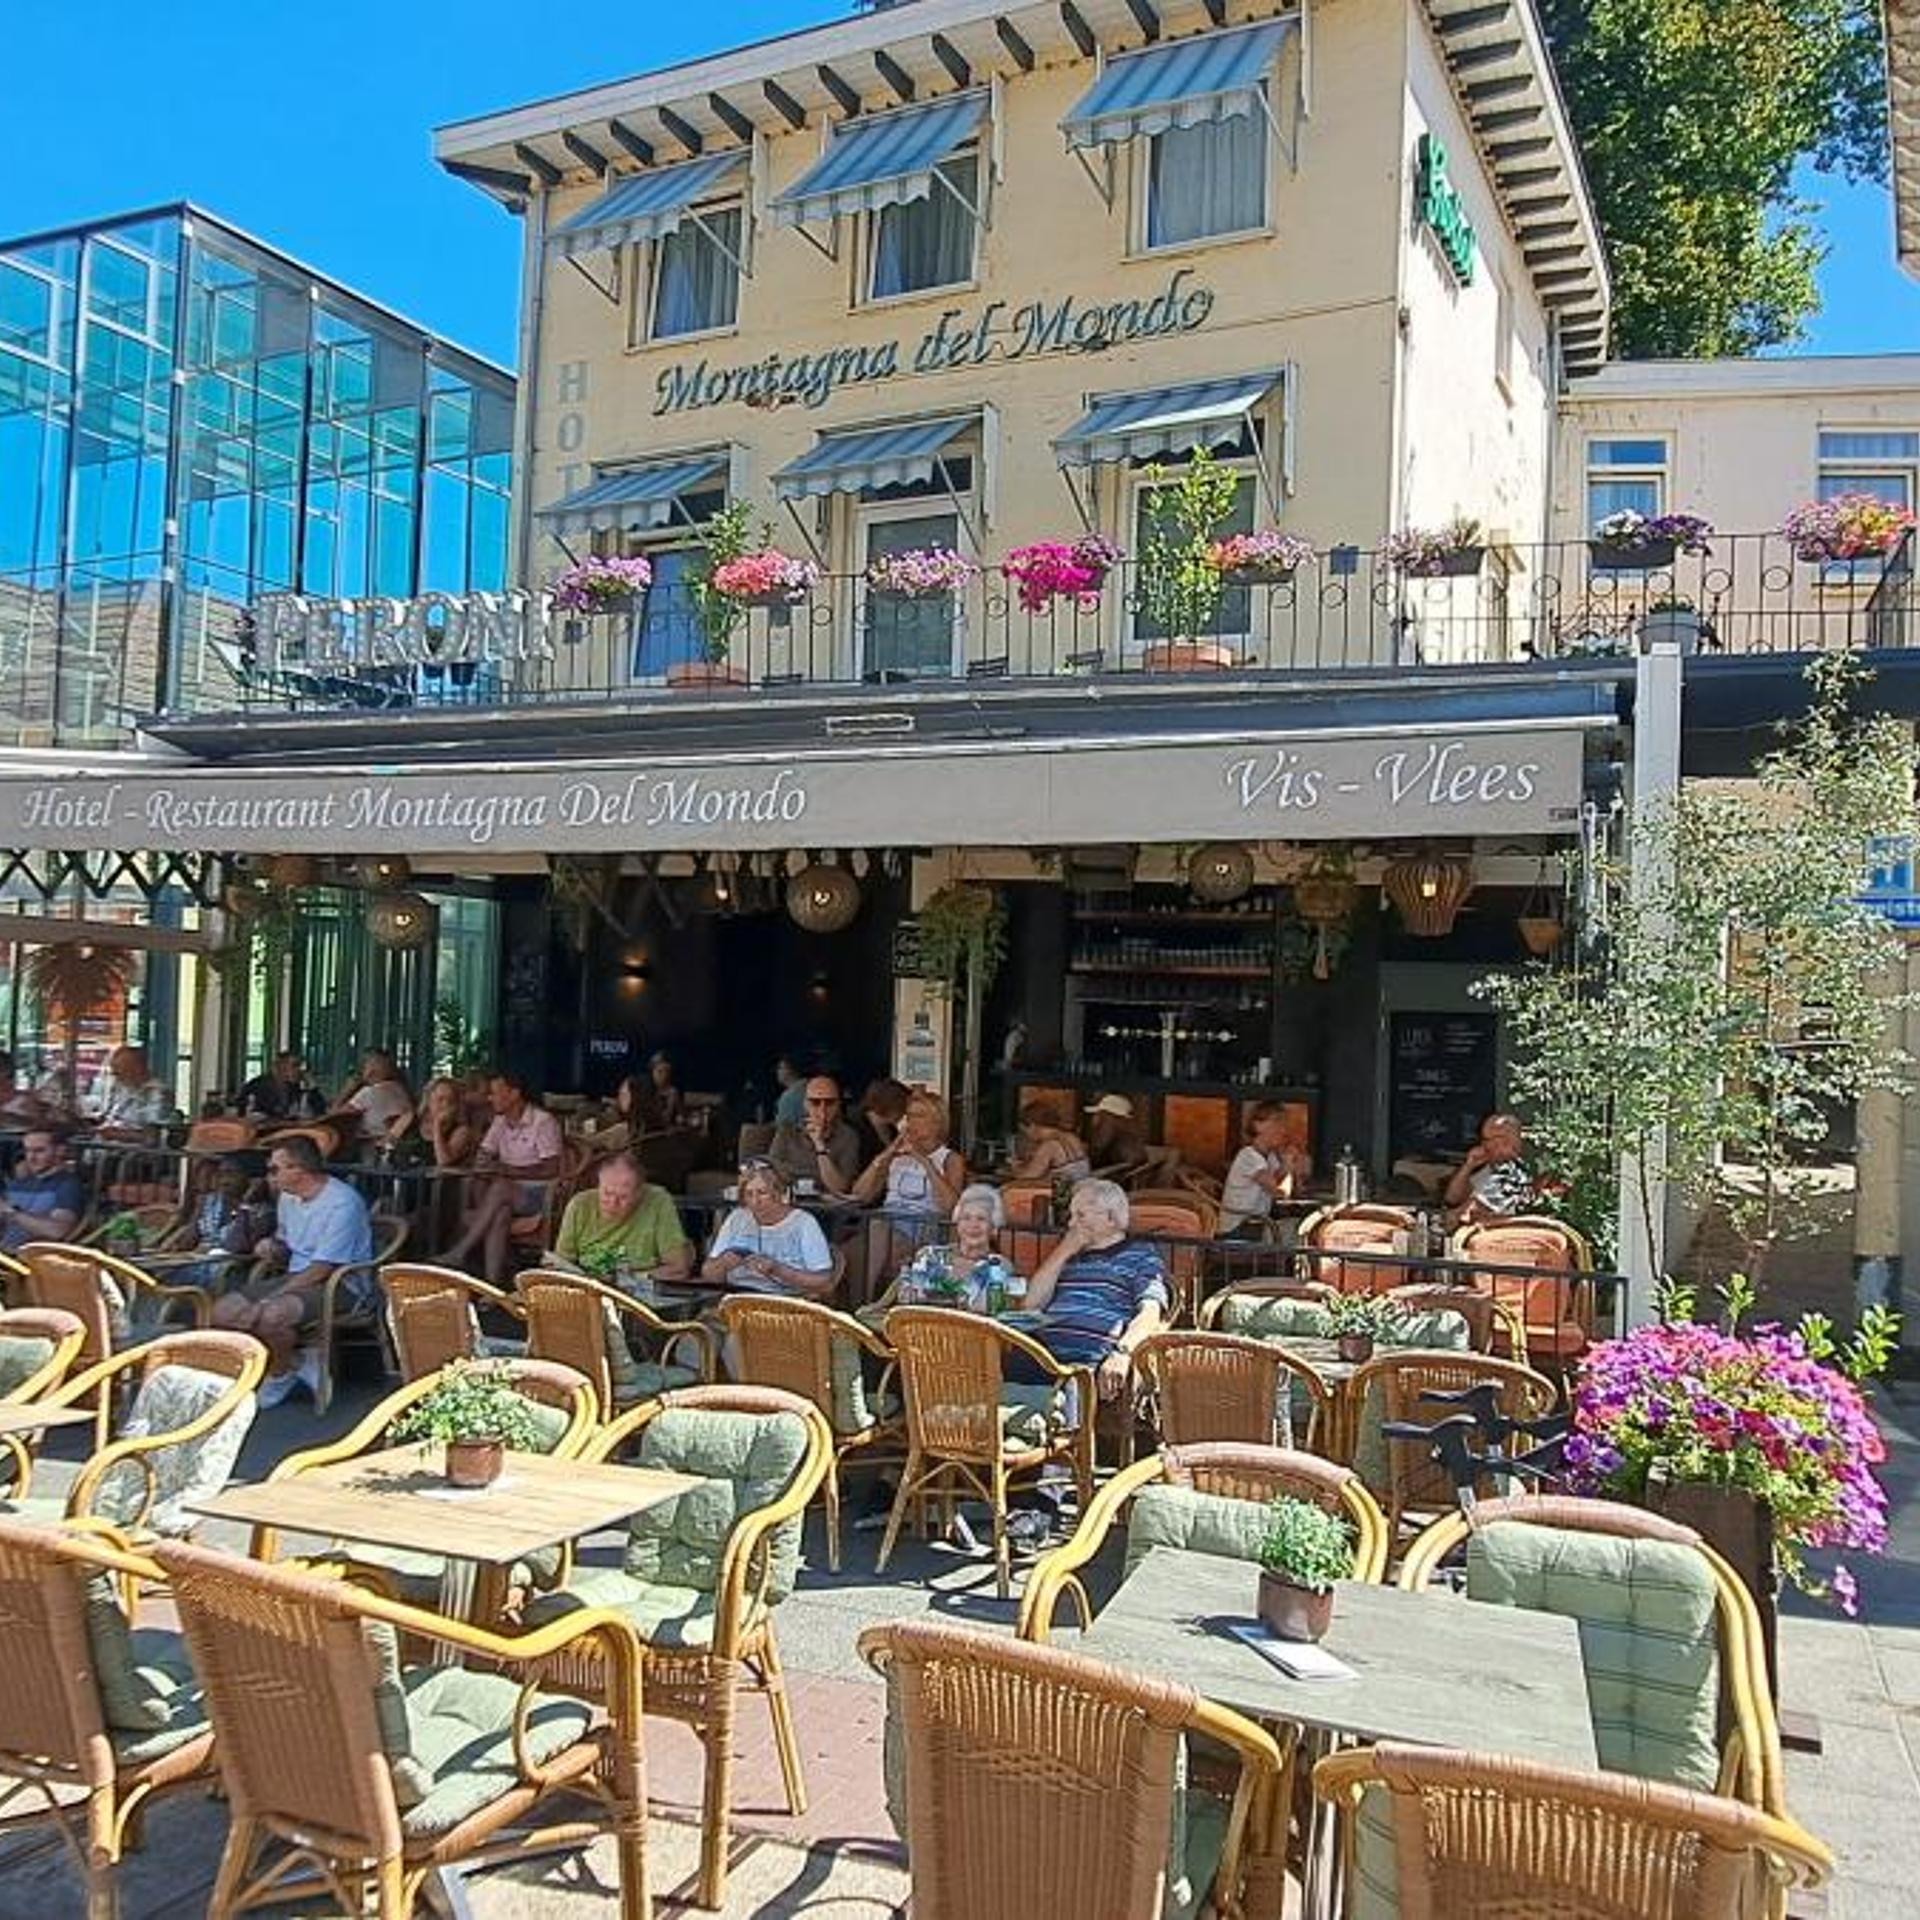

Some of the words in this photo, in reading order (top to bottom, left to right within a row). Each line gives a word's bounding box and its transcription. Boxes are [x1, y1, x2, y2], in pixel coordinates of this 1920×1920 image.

[652, 340, 897, 417] Montagna
[914, 301, 1004, 371] del
[1007, 268, 1215, 360] Mondo
[255, 586, 555, 675] PERONI
[22, 783, 122, 830] Hotel
[143, 789, 338, 836] Restaurant
[344, 786, 547, 843] Montagna
[558, 774, 645, 827] Del
[646, 769, 806, 826] Mondo
[1226, 749, 1324, 810] Vis
[1374, 741, 1540, 806] Vlees
